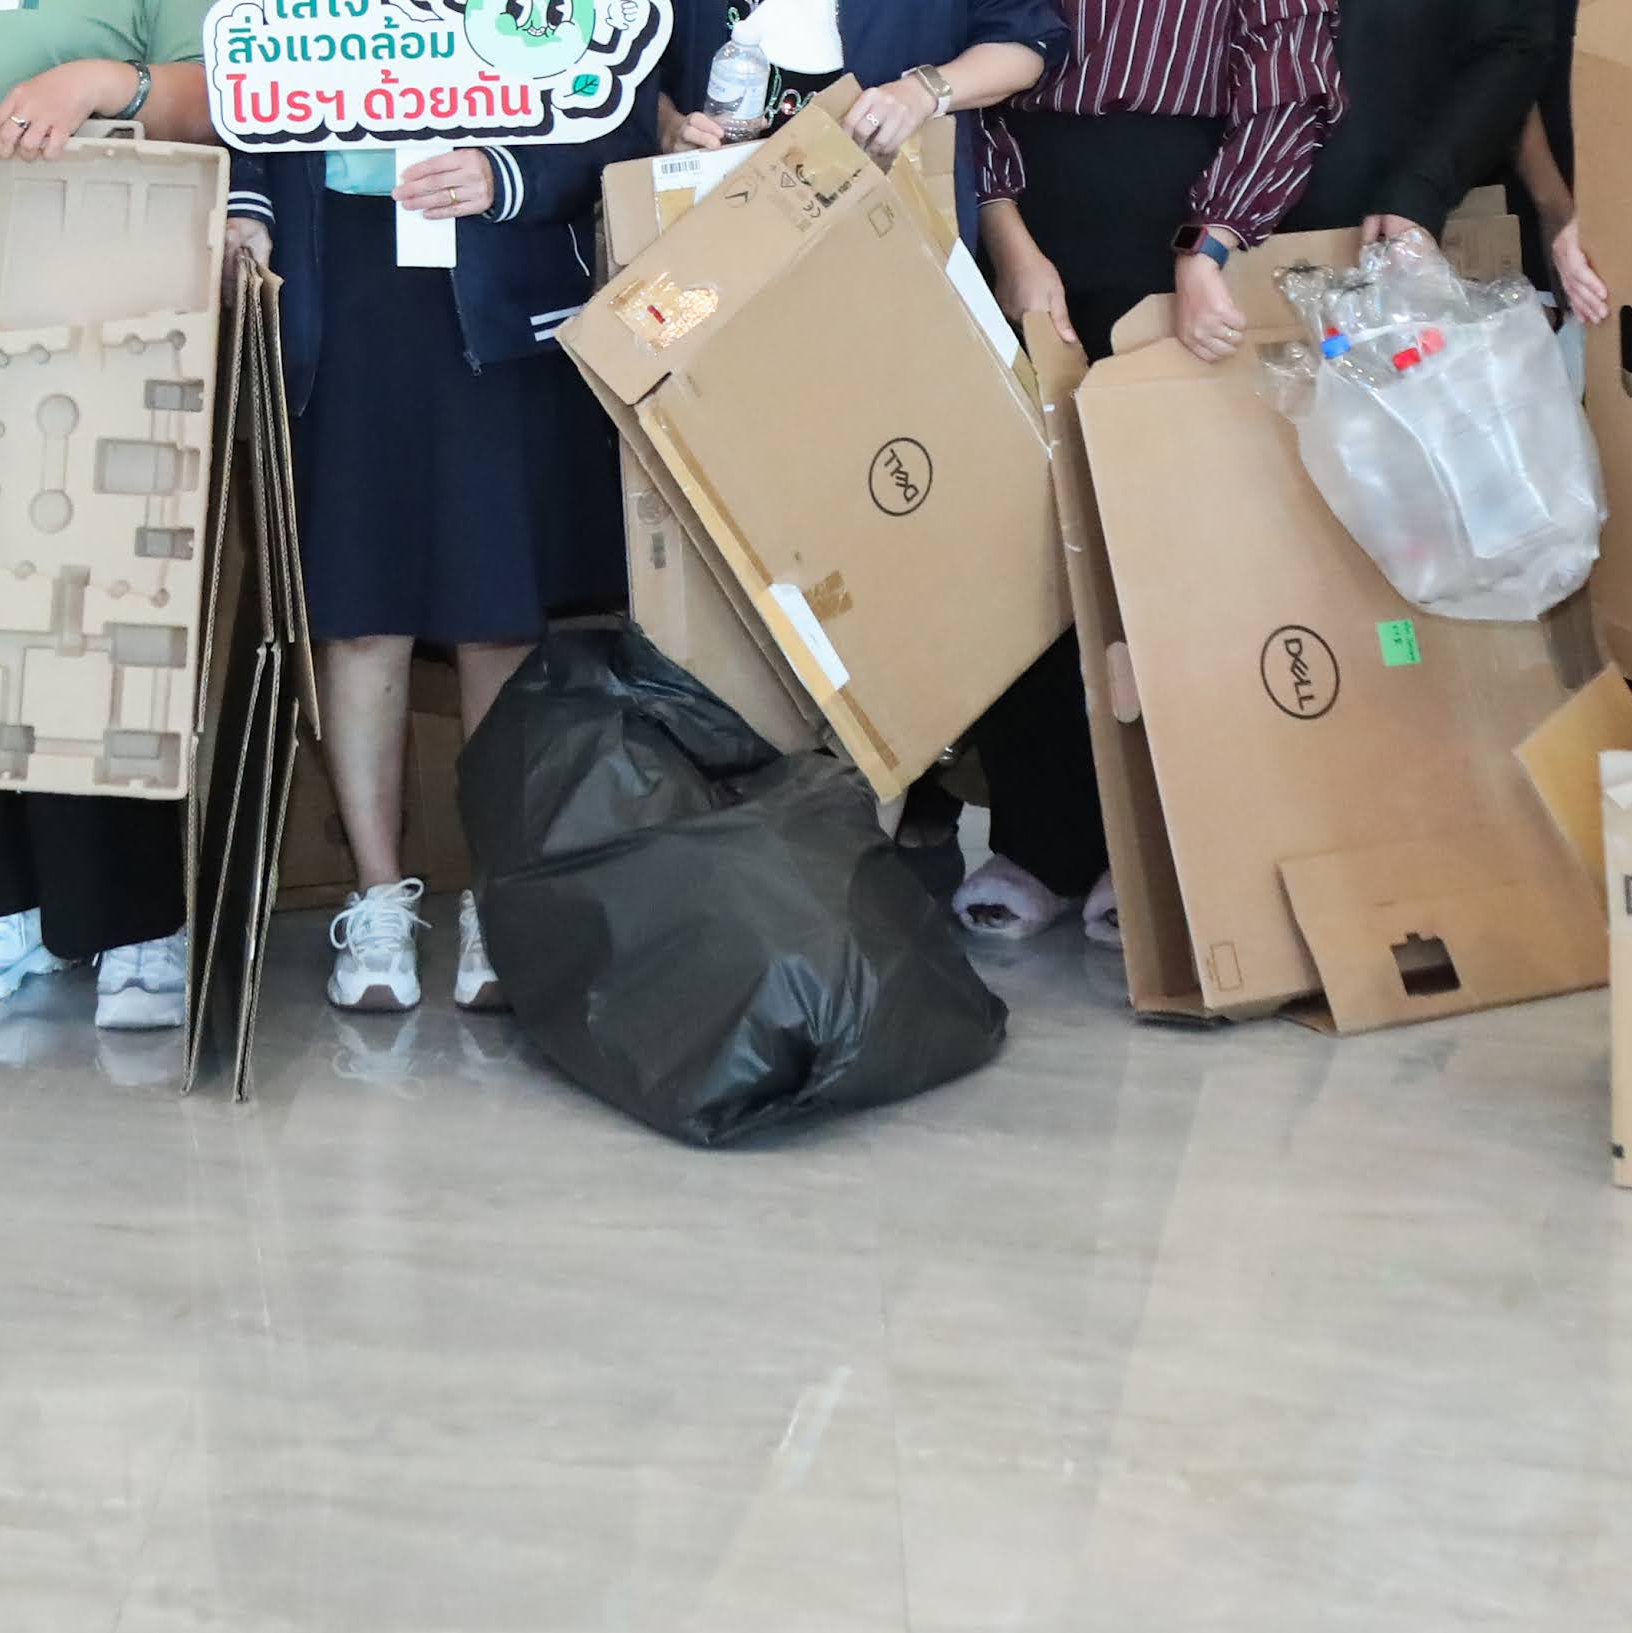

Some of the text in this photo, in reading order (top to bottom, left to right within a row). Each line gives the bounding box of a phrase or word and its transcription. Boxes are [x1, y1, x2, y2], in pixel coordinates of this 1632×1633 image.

[227, 16, 456, 65] สิ่งแวดล้อม
[227, 69, 533, 124] ไปรฯ ด้วยกัน
[884, 448, 919, 504] DELL
[1284, 638, 1314, 711] DELL
